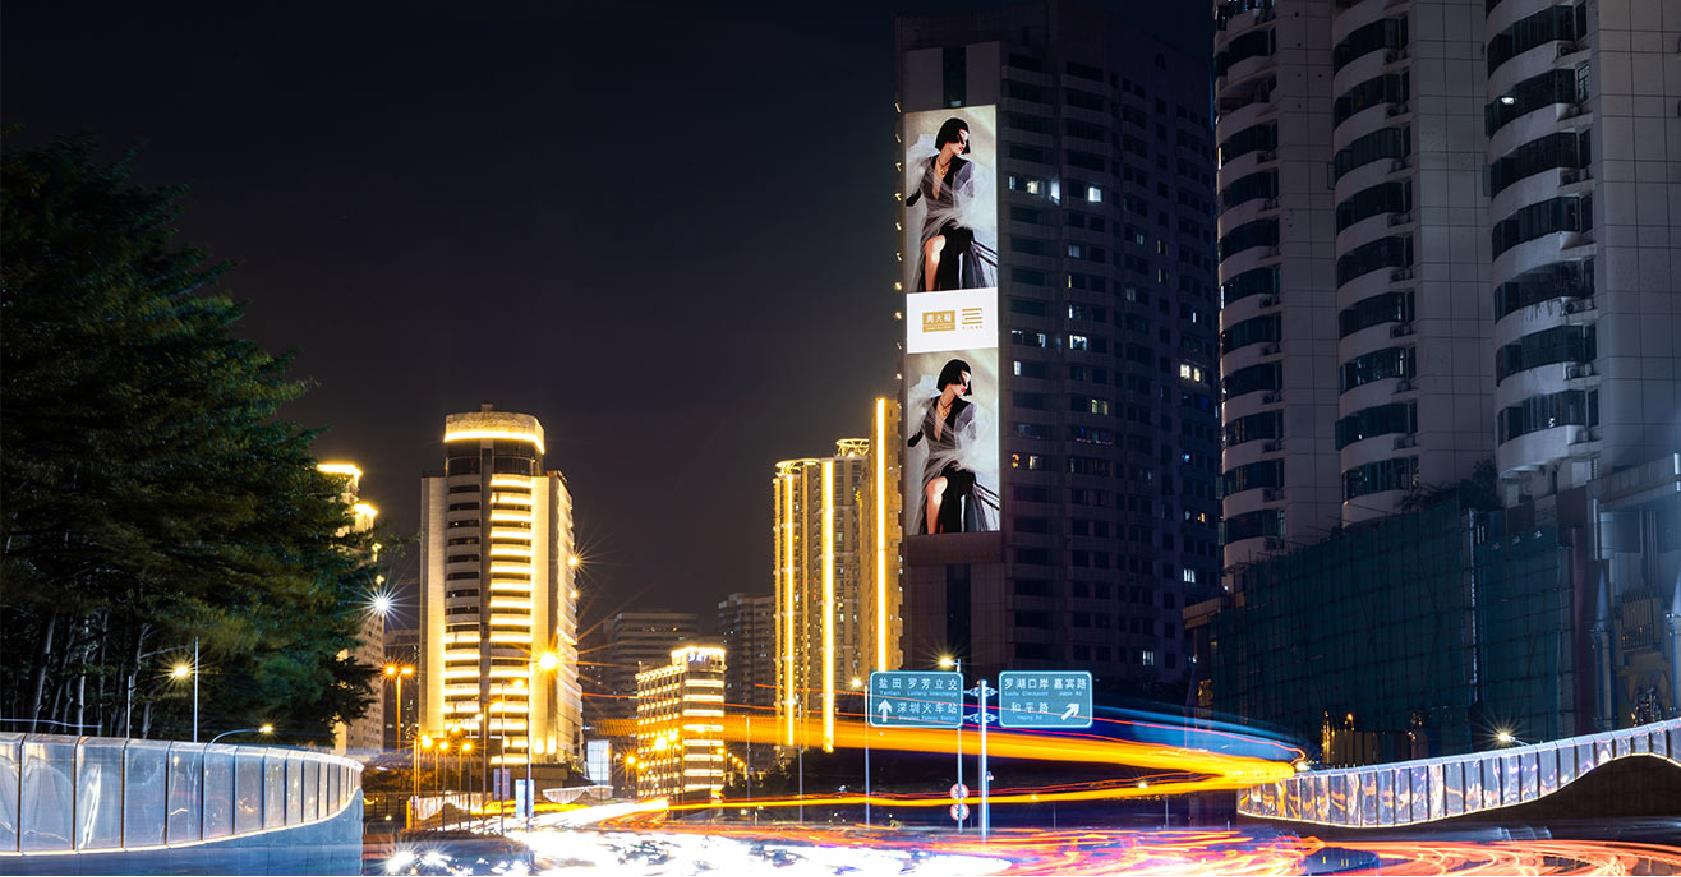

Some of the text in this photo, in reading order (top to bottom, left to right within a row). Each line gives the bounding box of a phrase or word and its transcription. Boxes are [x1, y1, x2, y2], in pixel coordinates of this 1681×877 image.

[896, 702, 958, 714] 深圳火车站
